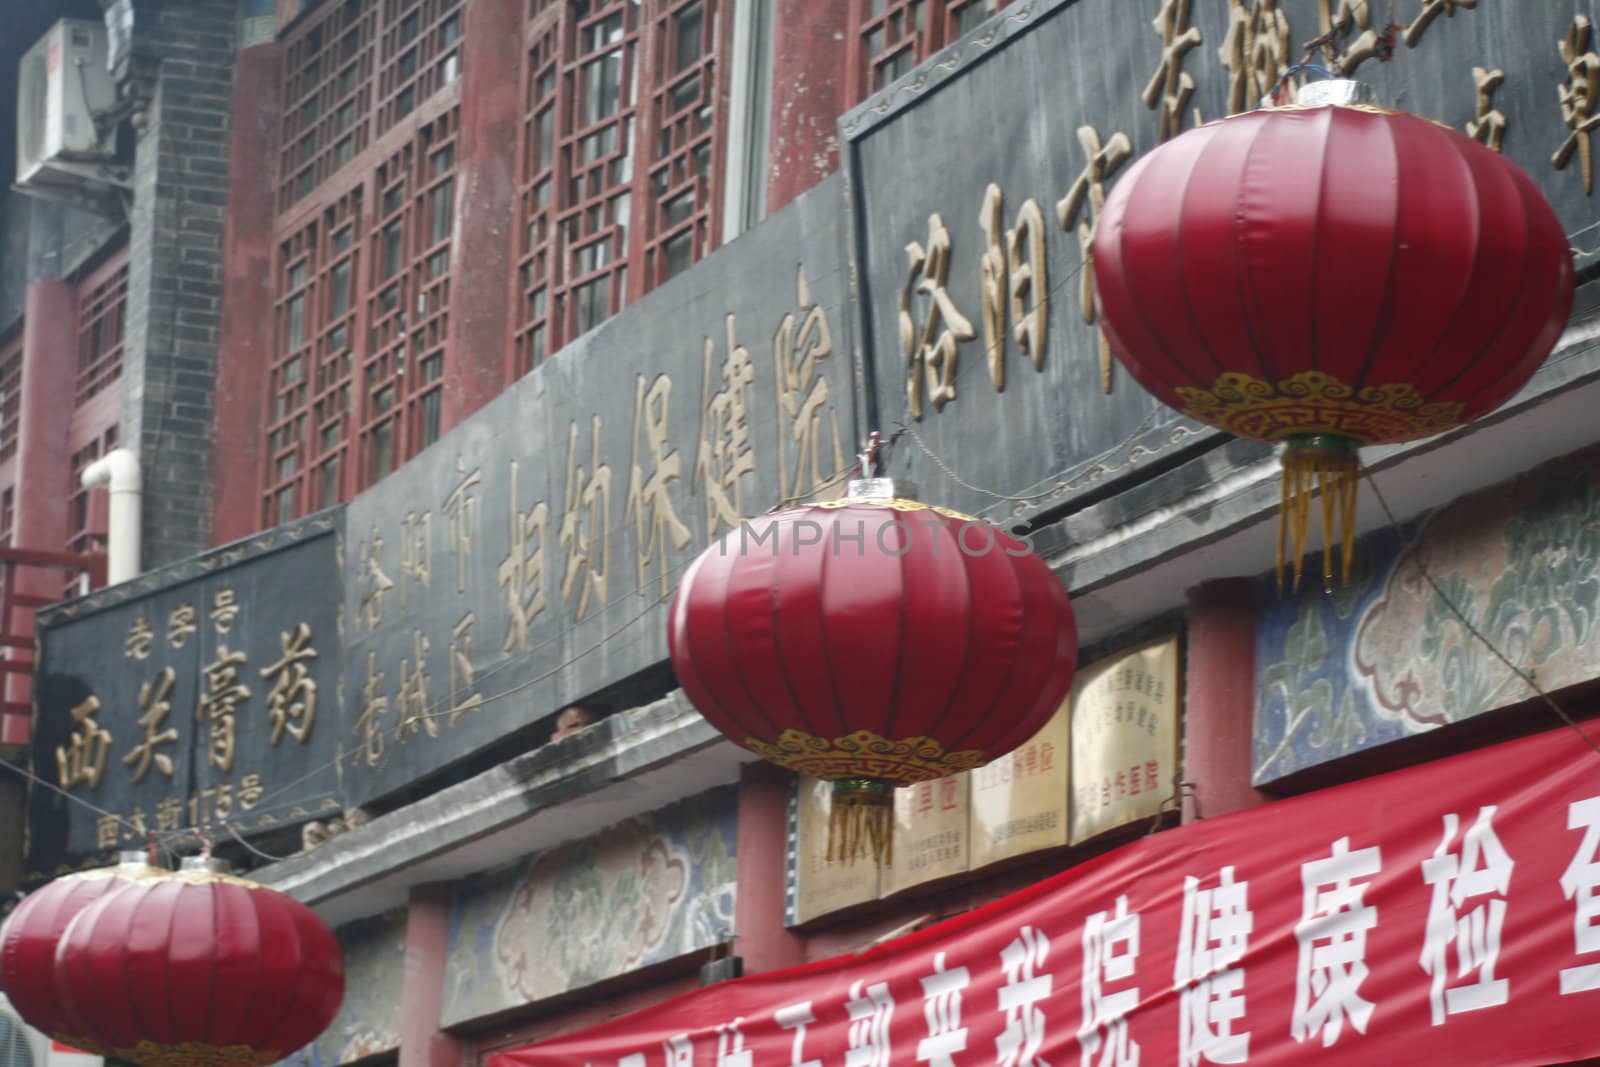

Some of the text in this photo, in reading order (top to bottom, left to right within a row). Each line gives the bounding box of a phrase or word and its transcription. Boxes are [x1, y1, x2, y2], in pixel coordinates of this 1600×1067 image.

[355, 454, 481, 630] 洛阳市
[125, 587, 240, 659] 老字号
